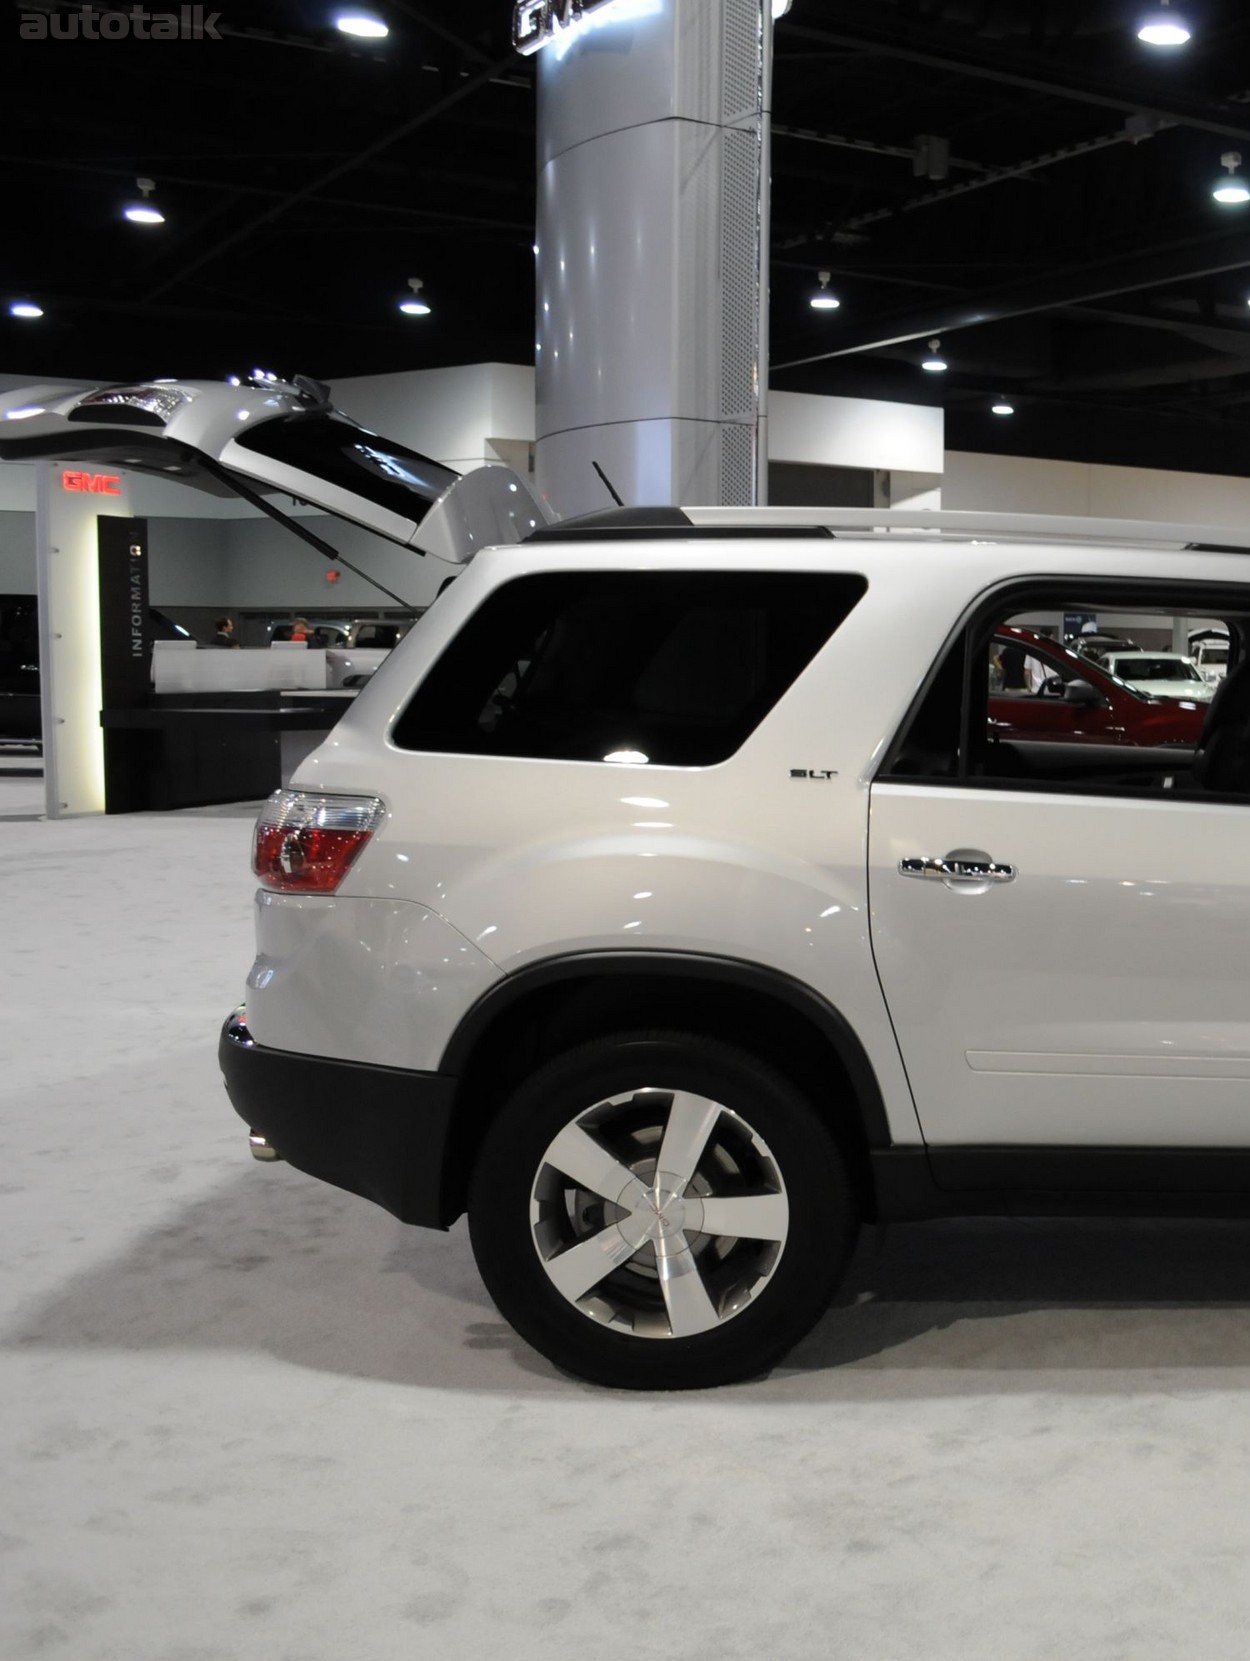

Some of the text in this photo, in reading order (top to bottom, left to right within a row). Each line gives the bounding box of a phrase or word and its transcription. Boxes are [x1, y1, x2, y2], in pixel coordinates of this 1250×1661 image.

[512, 0, 613, 56] GM
[62, 470, 121, 496] GMC
[129, 530, 143, 657] INFORMATION
